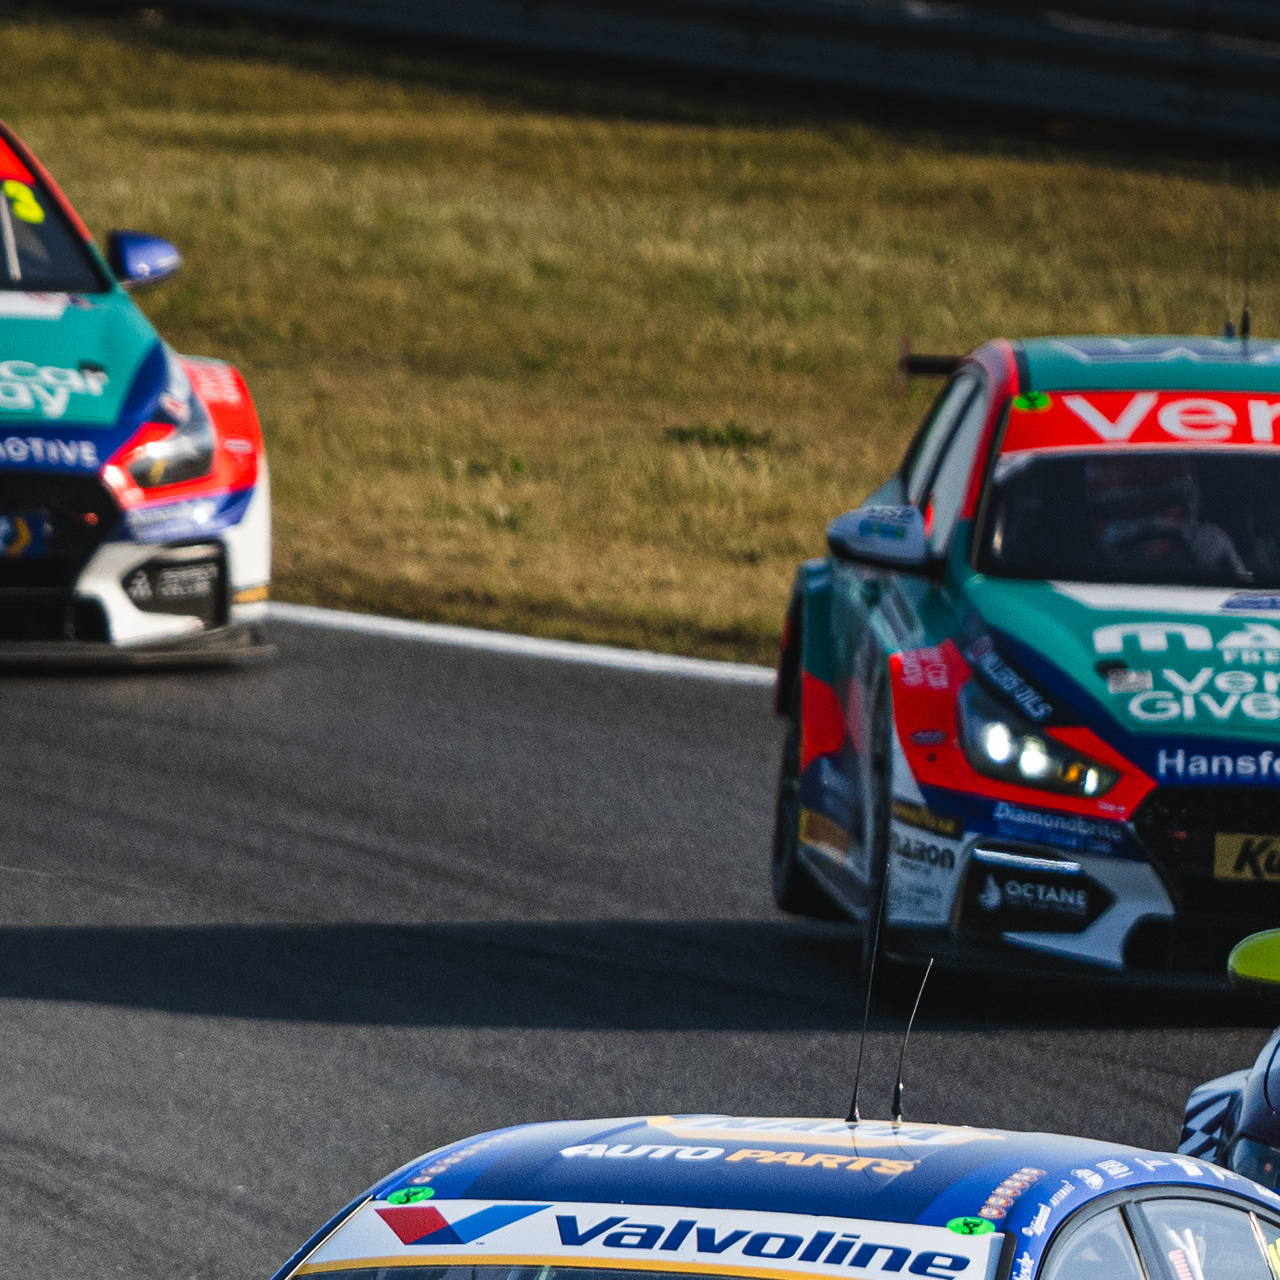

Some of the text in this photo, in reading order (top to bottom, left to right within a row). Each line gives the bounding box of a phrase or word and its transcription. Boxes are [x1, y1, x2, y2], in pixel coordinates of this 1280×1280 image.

[2, 180, 45, 224] 3
[1003, 879, 1088, 907] OCTANE
[560, 1144, 916, 1176] AUTO PARTS
[554, 1214, 972, 1280] Valvoline
